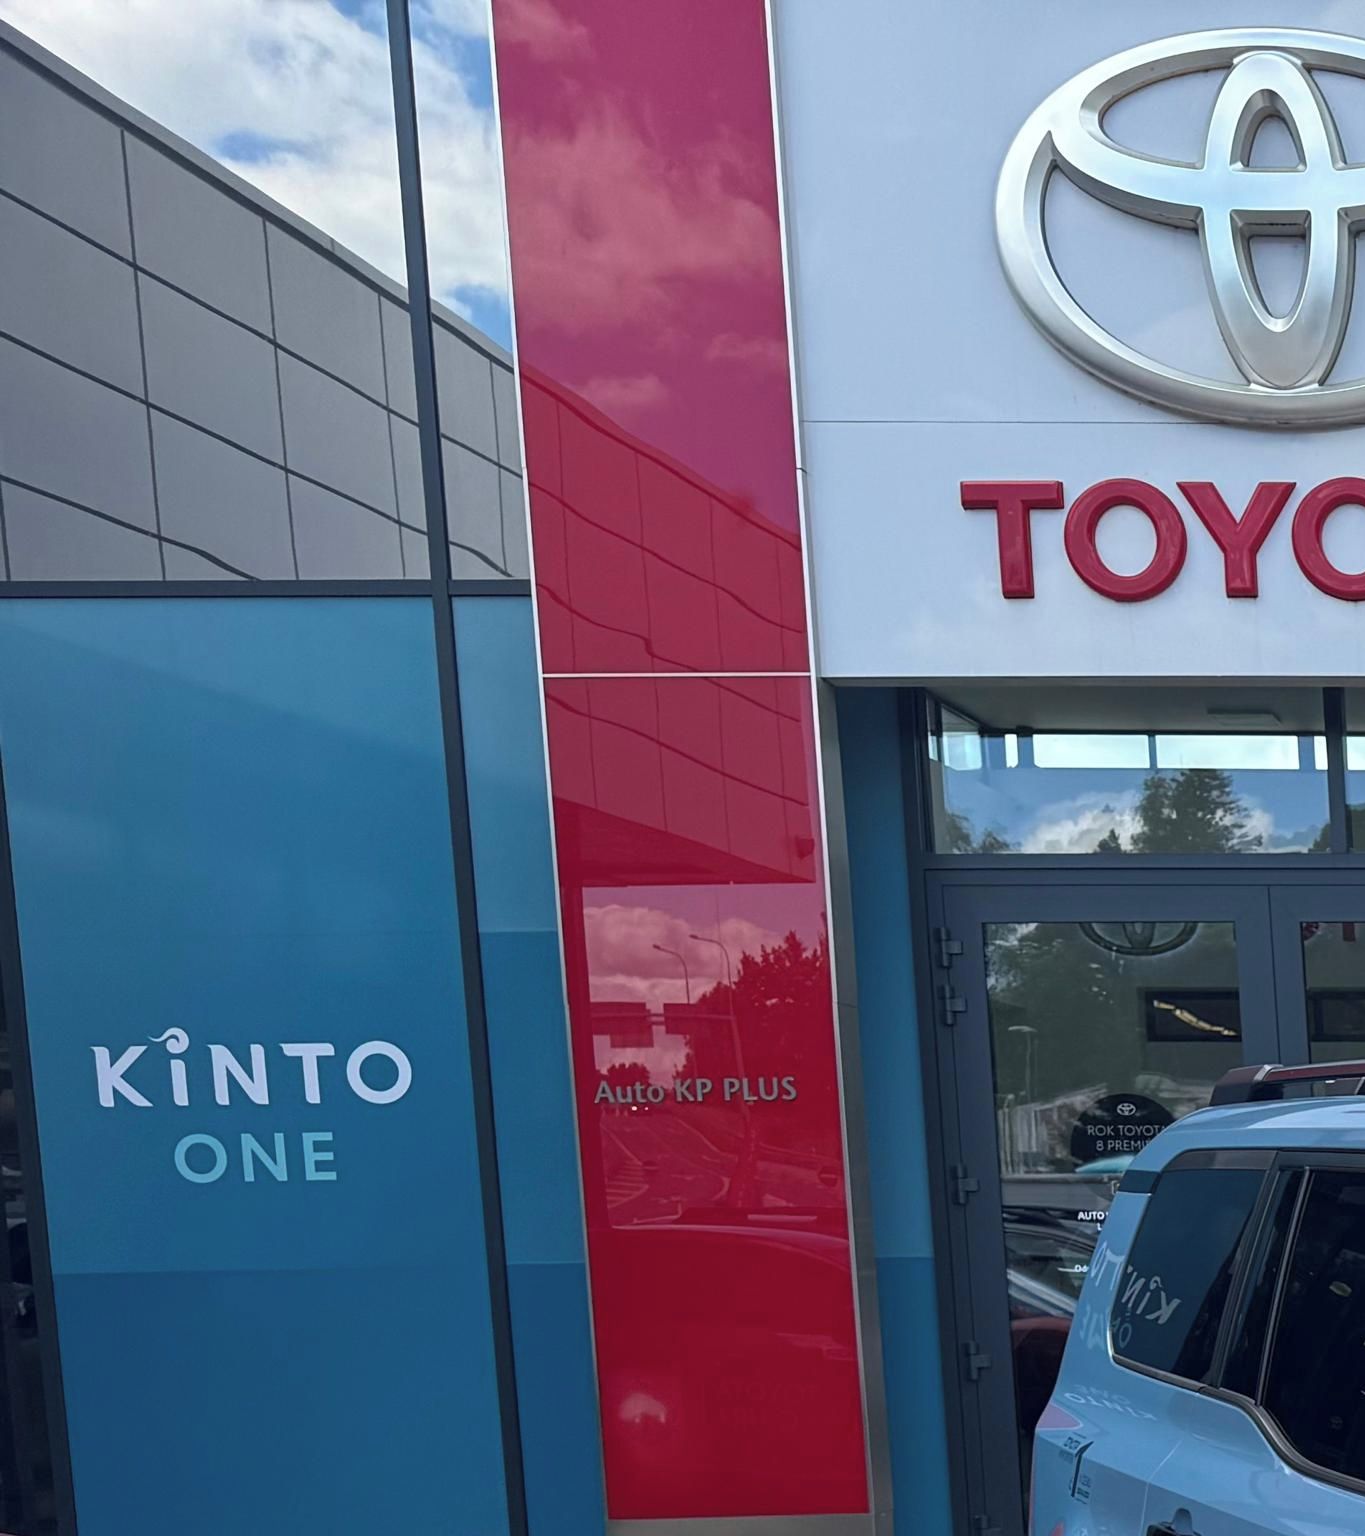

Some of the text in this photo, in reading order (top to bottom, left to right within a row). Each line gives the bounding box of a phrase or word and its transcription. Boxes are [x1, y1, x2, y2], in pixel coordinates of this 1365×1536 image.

[594, 1076, 797, 1104] Auto KP PLUS
[1087, 1125, 1115, 1136] ROK
[174, 1132, 337, 1184] ONE
